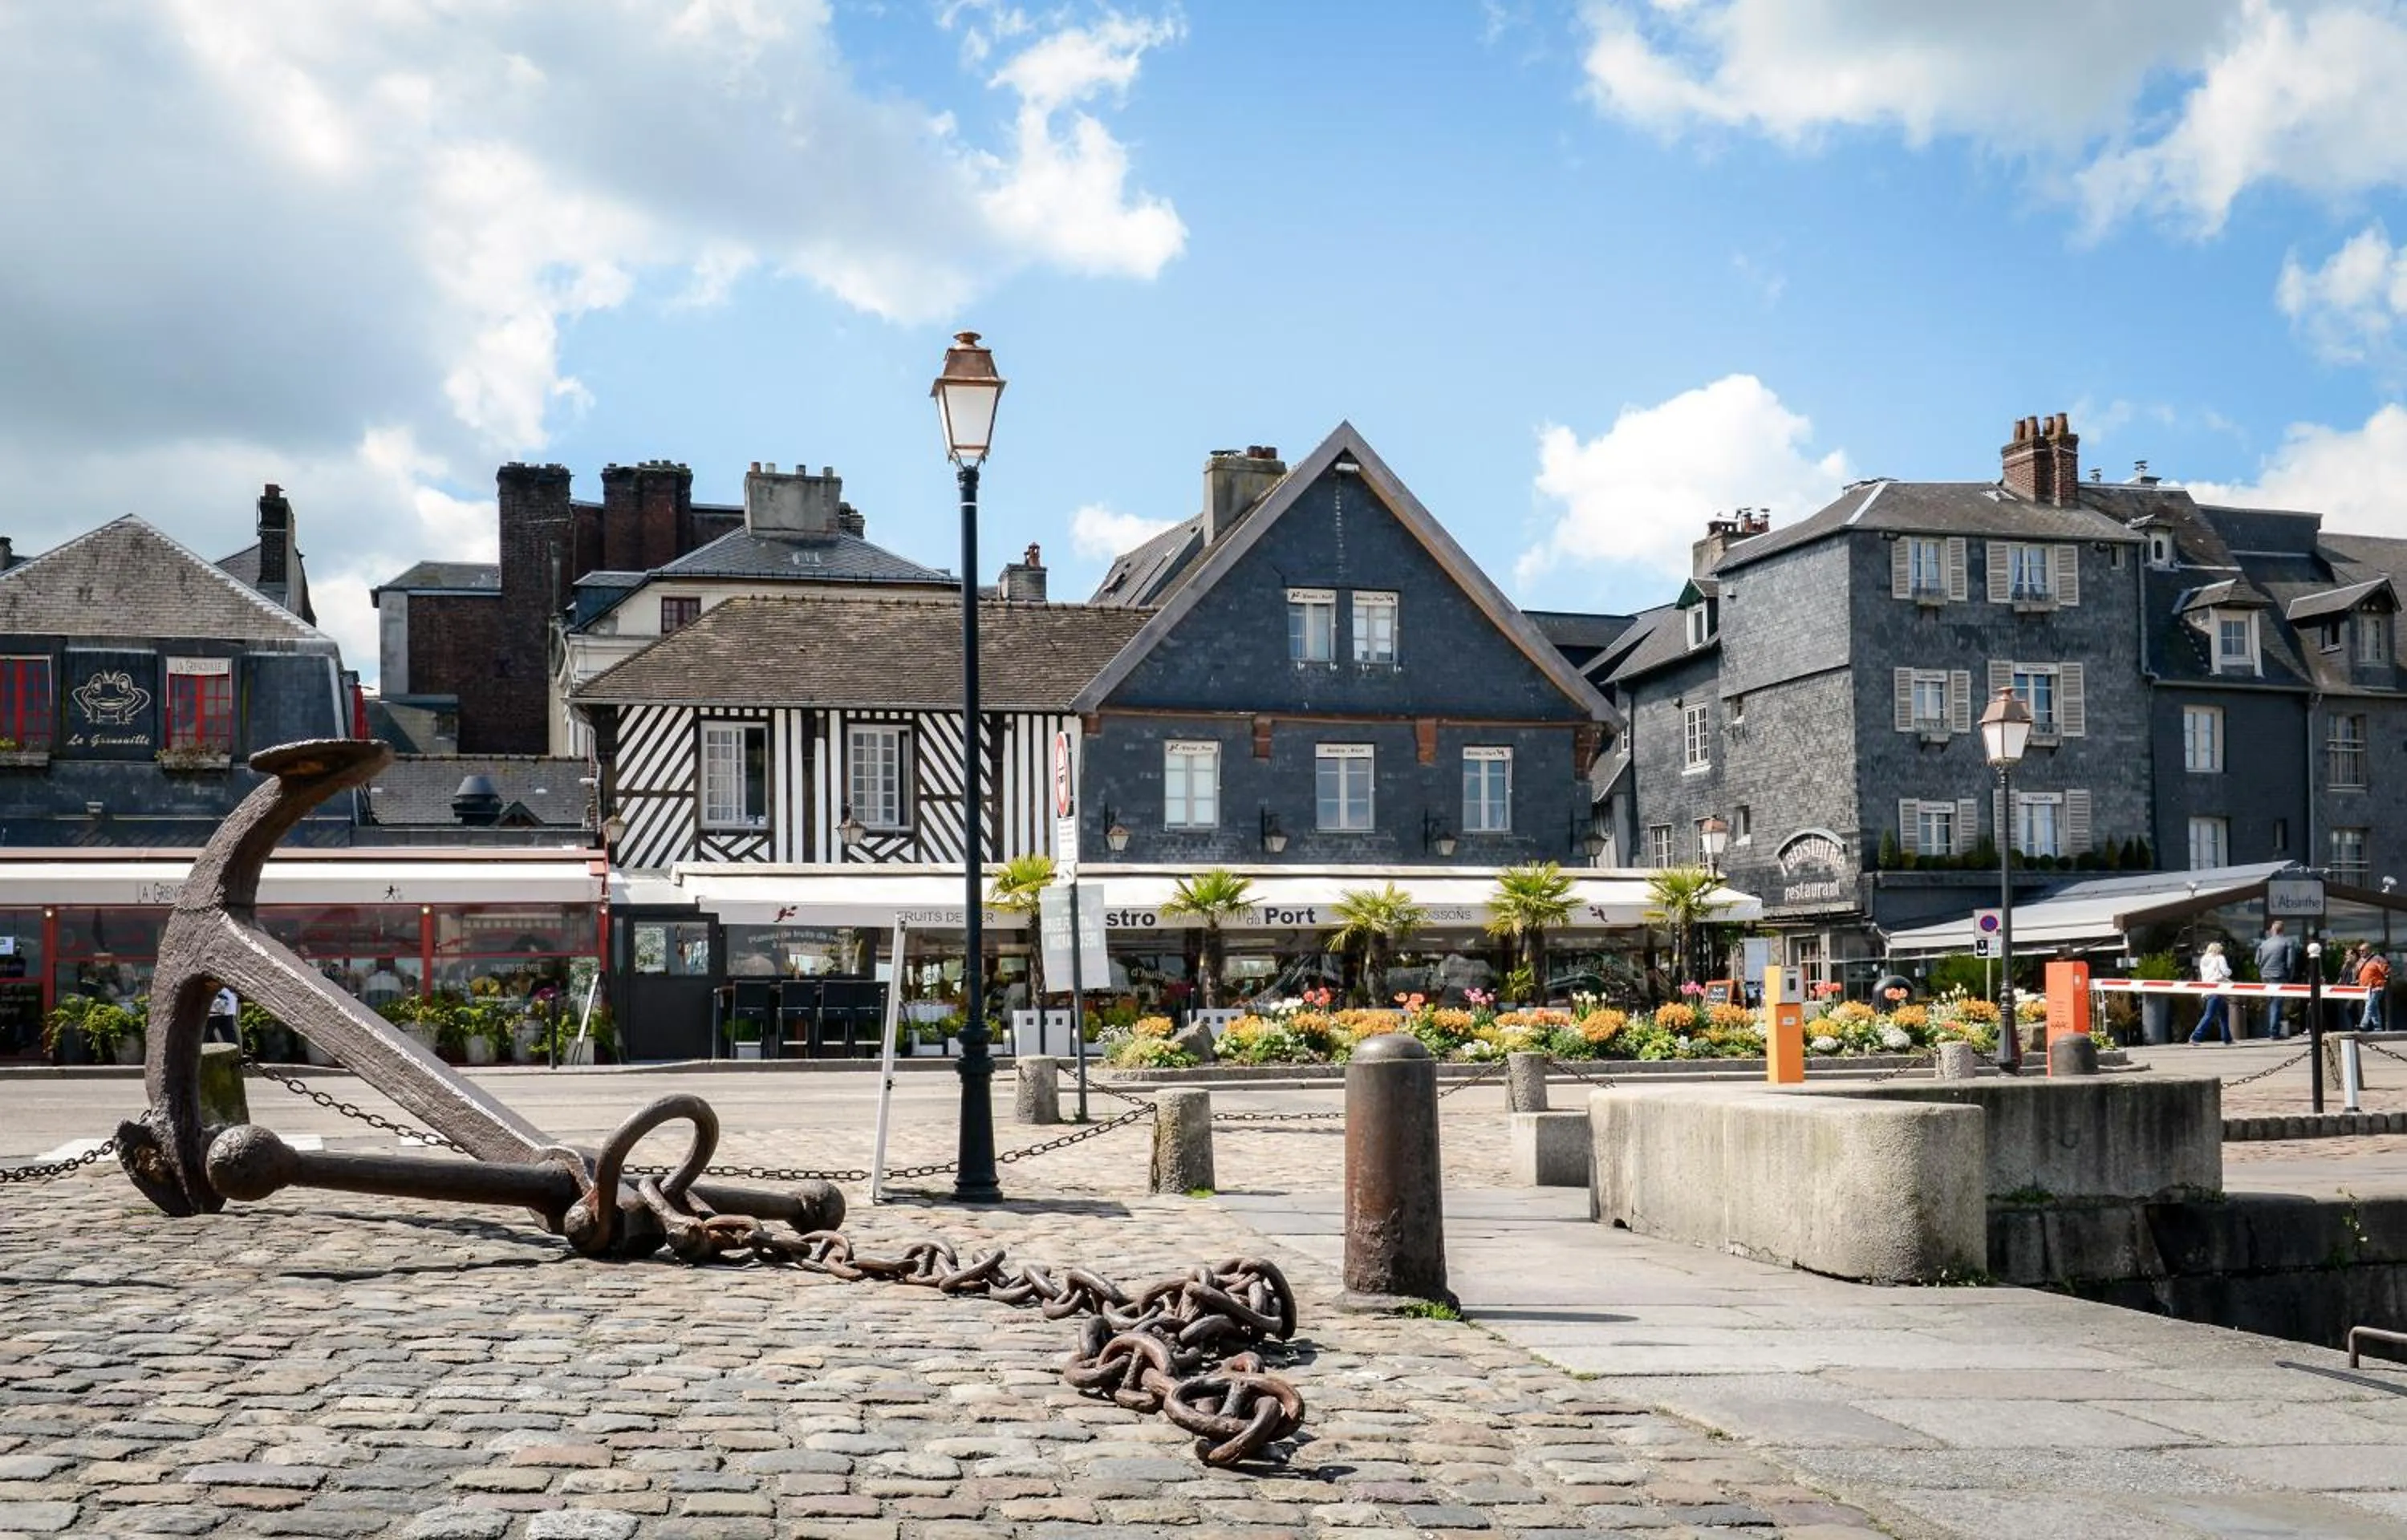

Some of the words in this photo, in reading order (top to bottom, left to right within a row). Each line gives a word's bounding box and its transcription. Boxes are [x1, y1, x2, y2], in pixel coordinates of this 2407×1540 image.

[1784, 879, 1840, 902] restaurant
[2270, 894, 2321, 908] L'Absinthe
[946, 912, 963, 922] DE
[1106, 907, 1156, 927] stro
[1246, 914, 1260, 925] du
[1264, 907, 1317, 925] Port
